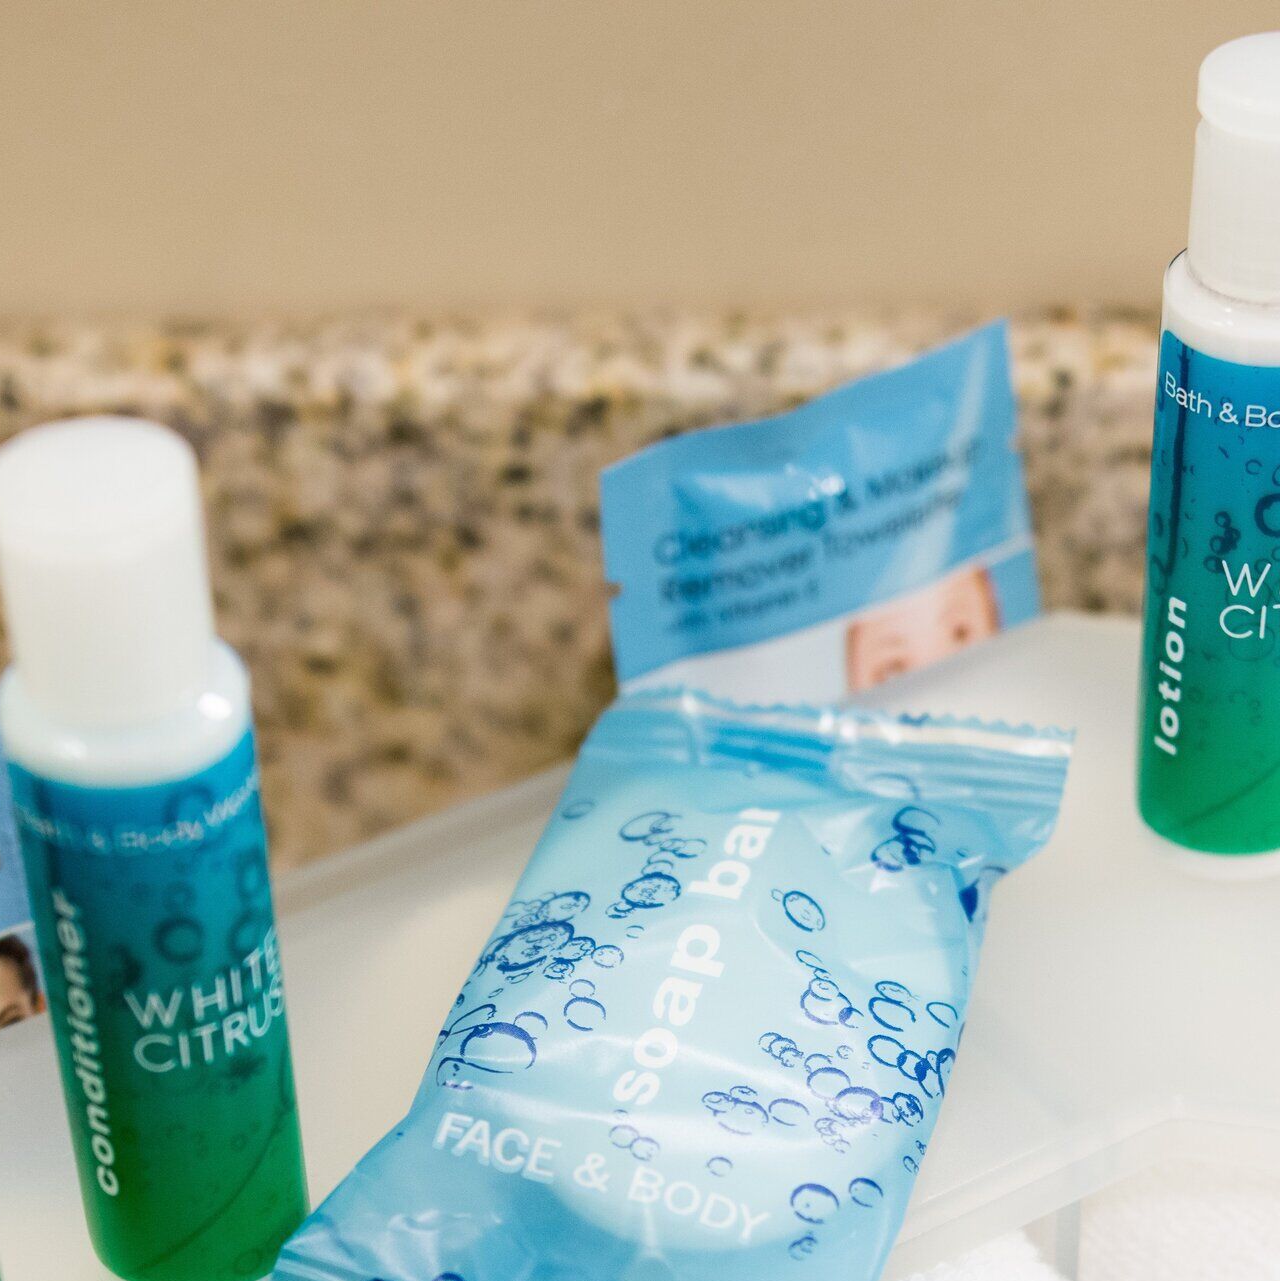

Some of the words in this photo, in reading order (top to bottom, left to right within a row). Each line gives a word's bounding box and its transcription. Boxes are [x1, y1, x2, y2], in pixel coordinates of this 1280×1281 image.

[1165, 371, 1212, 418] Bath
[1220, 402, 1239, 425] &
[1154, 596, 1187, 757] lotion
[123, 926, 281, 1029] WHITE
[613, 923, 725, 1106] soap
[687, 806, 781, 900] bar
[51, 889, 120, 1197] conditioner
[133, 974, 284, 1073] CITRUS
[432, 1111, 562, 1185] FACE
[573, 1152, 610, 1193] &
[627, 1165, 770, 1245] BODY
